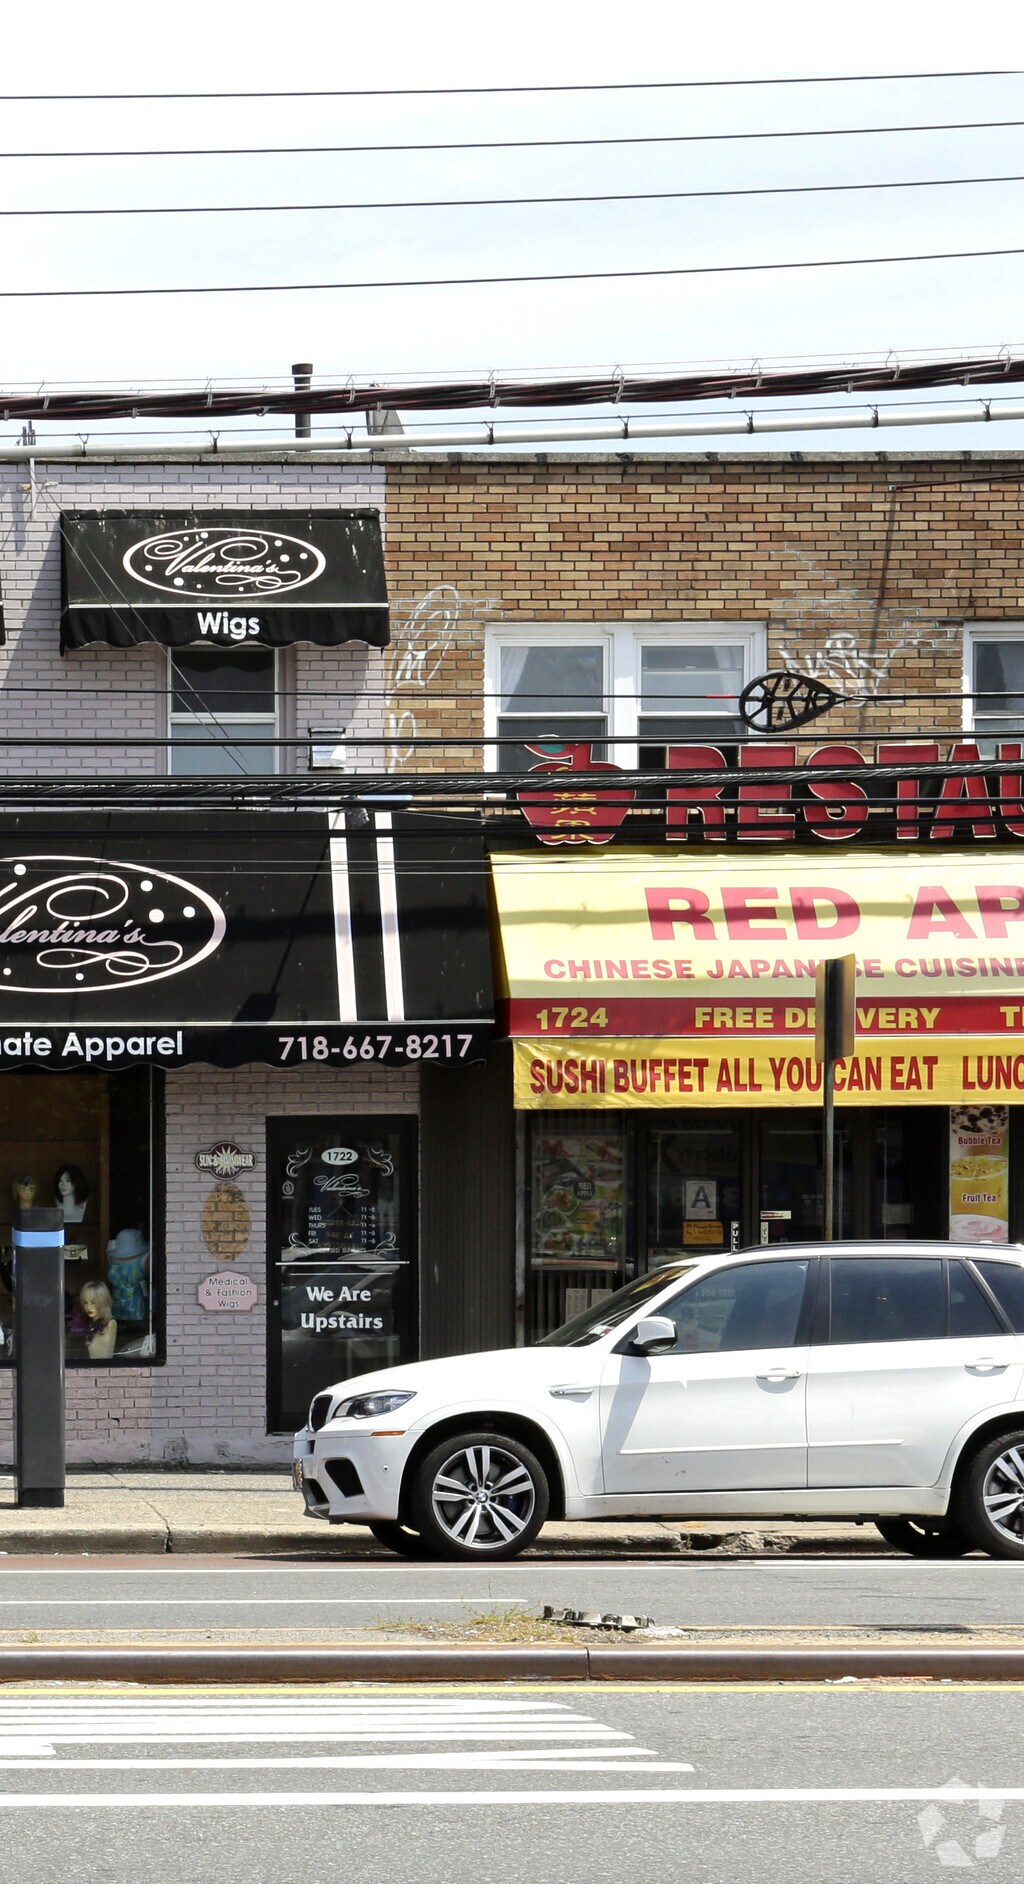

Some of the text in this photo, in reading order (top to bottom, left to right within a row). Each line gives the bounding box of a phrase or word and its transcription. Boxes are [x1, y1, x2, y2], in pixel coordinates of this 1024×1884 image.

[197, 612, 260, 637] Wigs
[644, 885, 1024, 940] RED AP
[543, 960, 692, 979] CHINESE
[706, 958, 885, 979] JAPANE
[536, 1005, 1024, 1030] 1724 FREE DVERY T
[62, 1032, 184, 1062] Apparel
[279, 1033, 472, 1060] 718-667-8217
[530, 1058, 606, 1095] SUSHI
[614, 1057, 709, 1093] BUFFET
[716, 1057, 762, 1092] ALL
[769, 1056, 822, 1092] YOU
[833, 1056, 883, 1091] CAN
[890, 1055, 938, 1091] EAT
[958, 1137, 1001, 1145] Bubble Tea
[327, 1151, 353, 1161] 1722
[690, 1185, 712, 1209] A
[962, 1193, 997, 1202] Fruit Tea
[205, 1288, 252, 1297] & Fashion
[209, 1278, 248, 1286] Medical
[218, 1300, 240, 1309] Wigs
[306, 1286, 372, 1302] We Are
[300, 1313, 383, 1334] Upstairs
